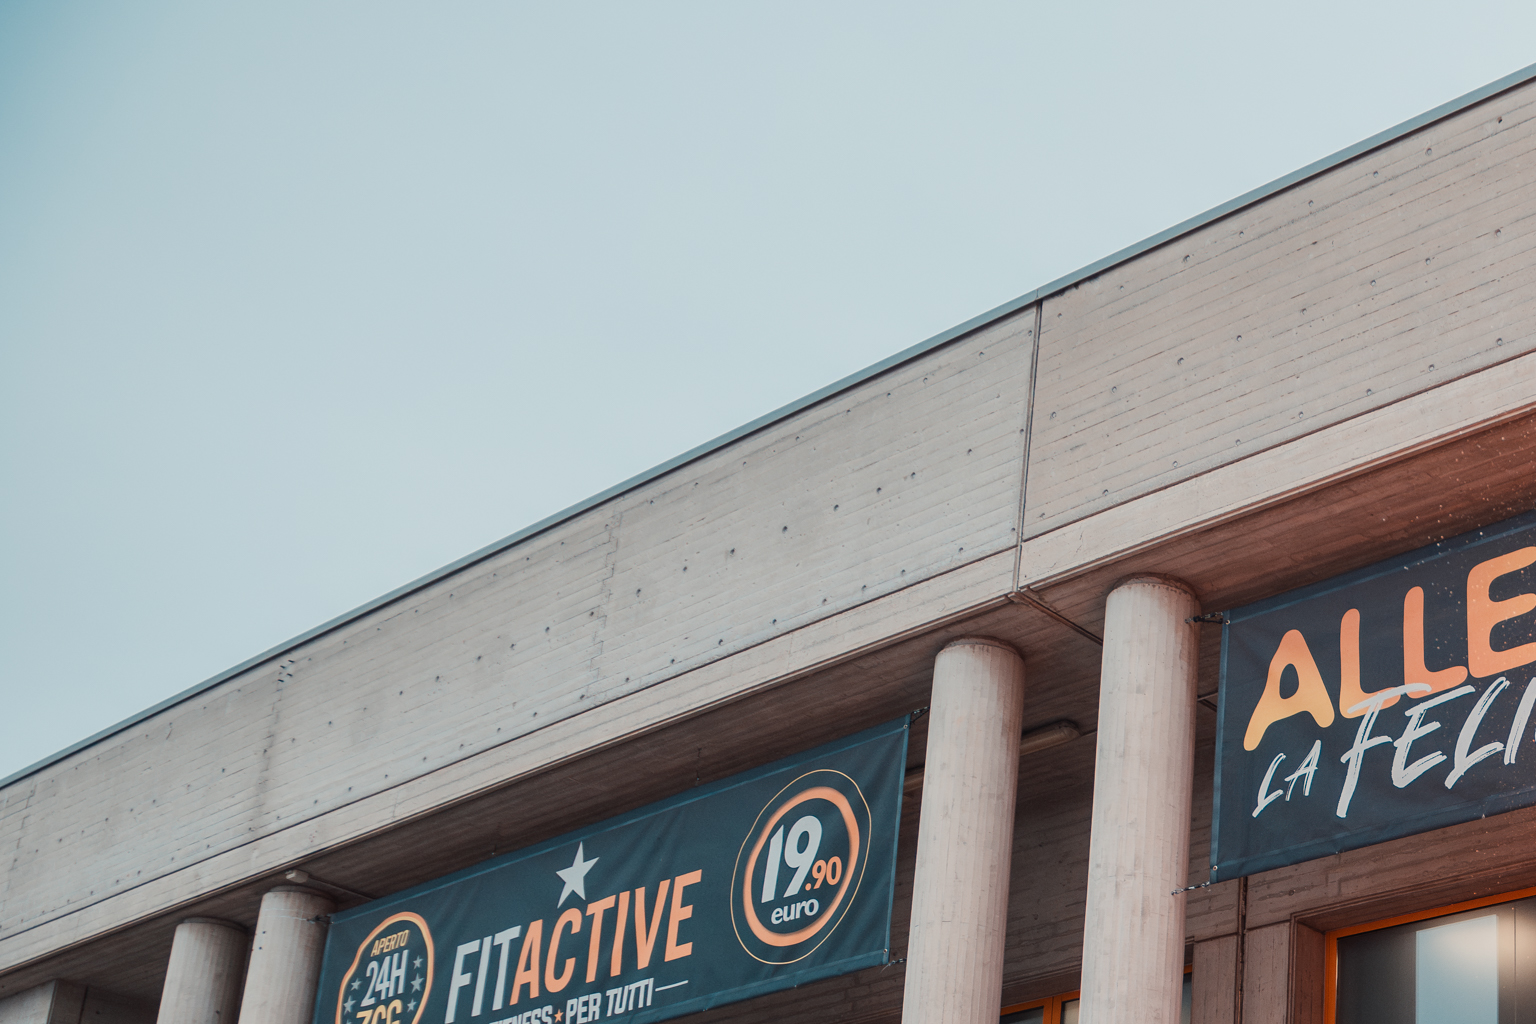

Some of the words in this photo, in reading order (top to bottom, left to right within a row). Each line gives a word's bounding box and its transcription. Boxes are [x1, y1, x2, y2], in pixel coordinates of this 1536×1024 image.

[1252, 739, 1321, 818] LA
[761, 815, 842, 903] 19.90
[771, 898, 819, 924] euro
[370, 929, 410, 957] APERTO
[445, 869, 702, 1024] FITACTIVE
[360, 949, 409, 1007] 24H
[606, 978, 654, 1017] TUTTI
